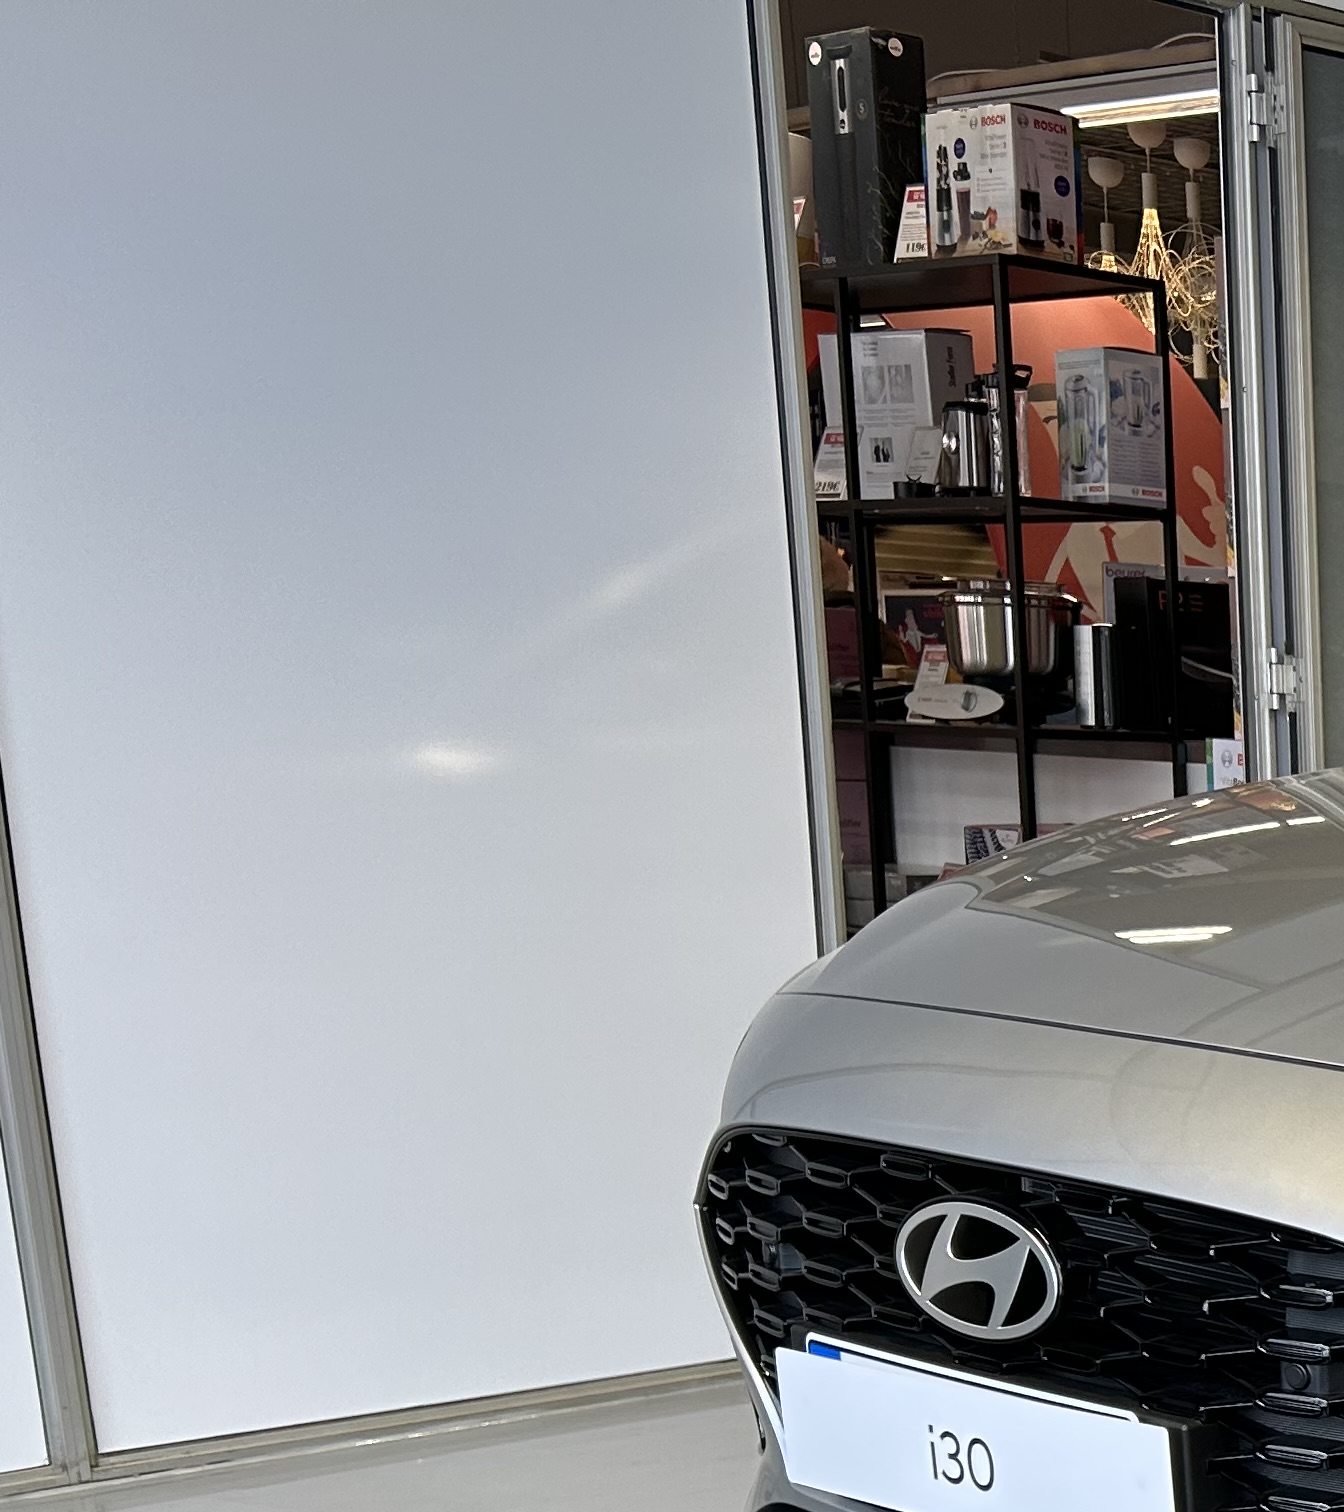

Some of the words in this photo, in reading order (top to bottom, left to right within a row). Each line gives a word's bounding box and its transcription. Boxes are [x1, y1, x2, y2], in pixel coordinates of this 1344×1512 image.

[981, 114, 1006, 127] BOSCH
[1033, 119, 1068, 135] BOSCH
[926, 1424, 995, 1492] i30
